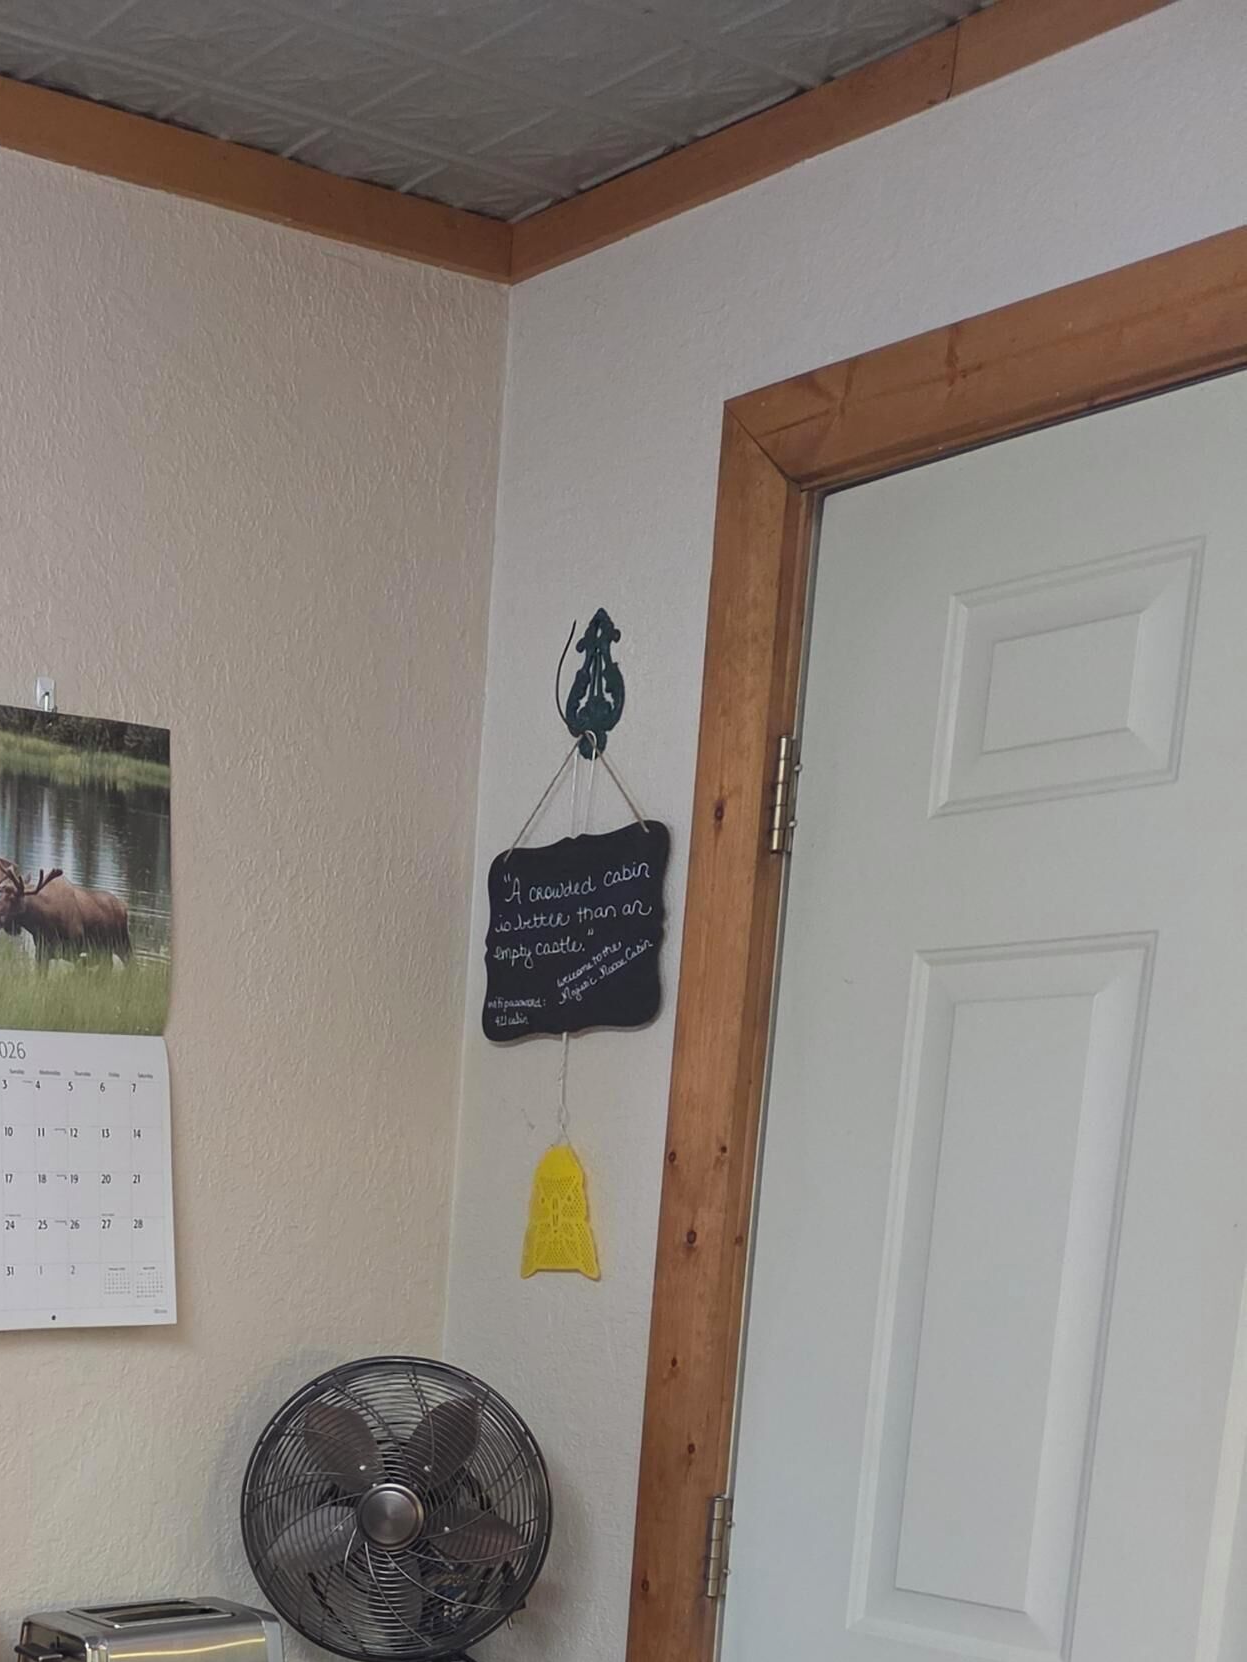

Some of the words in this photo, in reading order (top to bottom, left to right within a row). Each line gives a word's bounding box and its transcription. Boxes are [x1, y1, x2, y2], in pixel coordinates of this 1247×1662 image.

[529, 876, 597, 902] crowded
[604, 862, 650, 887] cabin
[495, 914, 511, 933] is
[514, 914, 570, 931] better
[577, 907, 617, 923] than
[622, 900, 652, 915] an
[493, 944, 533, 969] empty
[2, 1079, 8, 1090] 3
[35, 1080, 41, 1090] 4
[68, 1081, 74, 1092] 5
[99, 1082, 106, 1093] 6
[131, 1082, 137, 1093] 7
[4, 1126, 14, 1137] 10
[37, 1127, 45, 1137] 11
[69, 1127, 78, 1138] 12
[101, 1128, 111, 1139] 13
[133, 1128, 142, 1139] 14
[4, 1173, 14, 1184] 17
[37, 1173, 47, 1184] 18
[70, 1174, 79, 1184] 19
[101, 1173, 112, 1185] 20
[132, 1174, 141, 1184] 21
[5, 1220, 15, 1231] 24
[38, 1219, 48, 1230] 25
[70, 1219, 80, 1230] 26
[101, 1218, 112, 1230] 27
[133, 1218, 143, 1229] 28
[6, 1265, 15, 1277] 31
[39, 1265, 43, 1276] 1
[70, 1264, 76, 1275] 2
